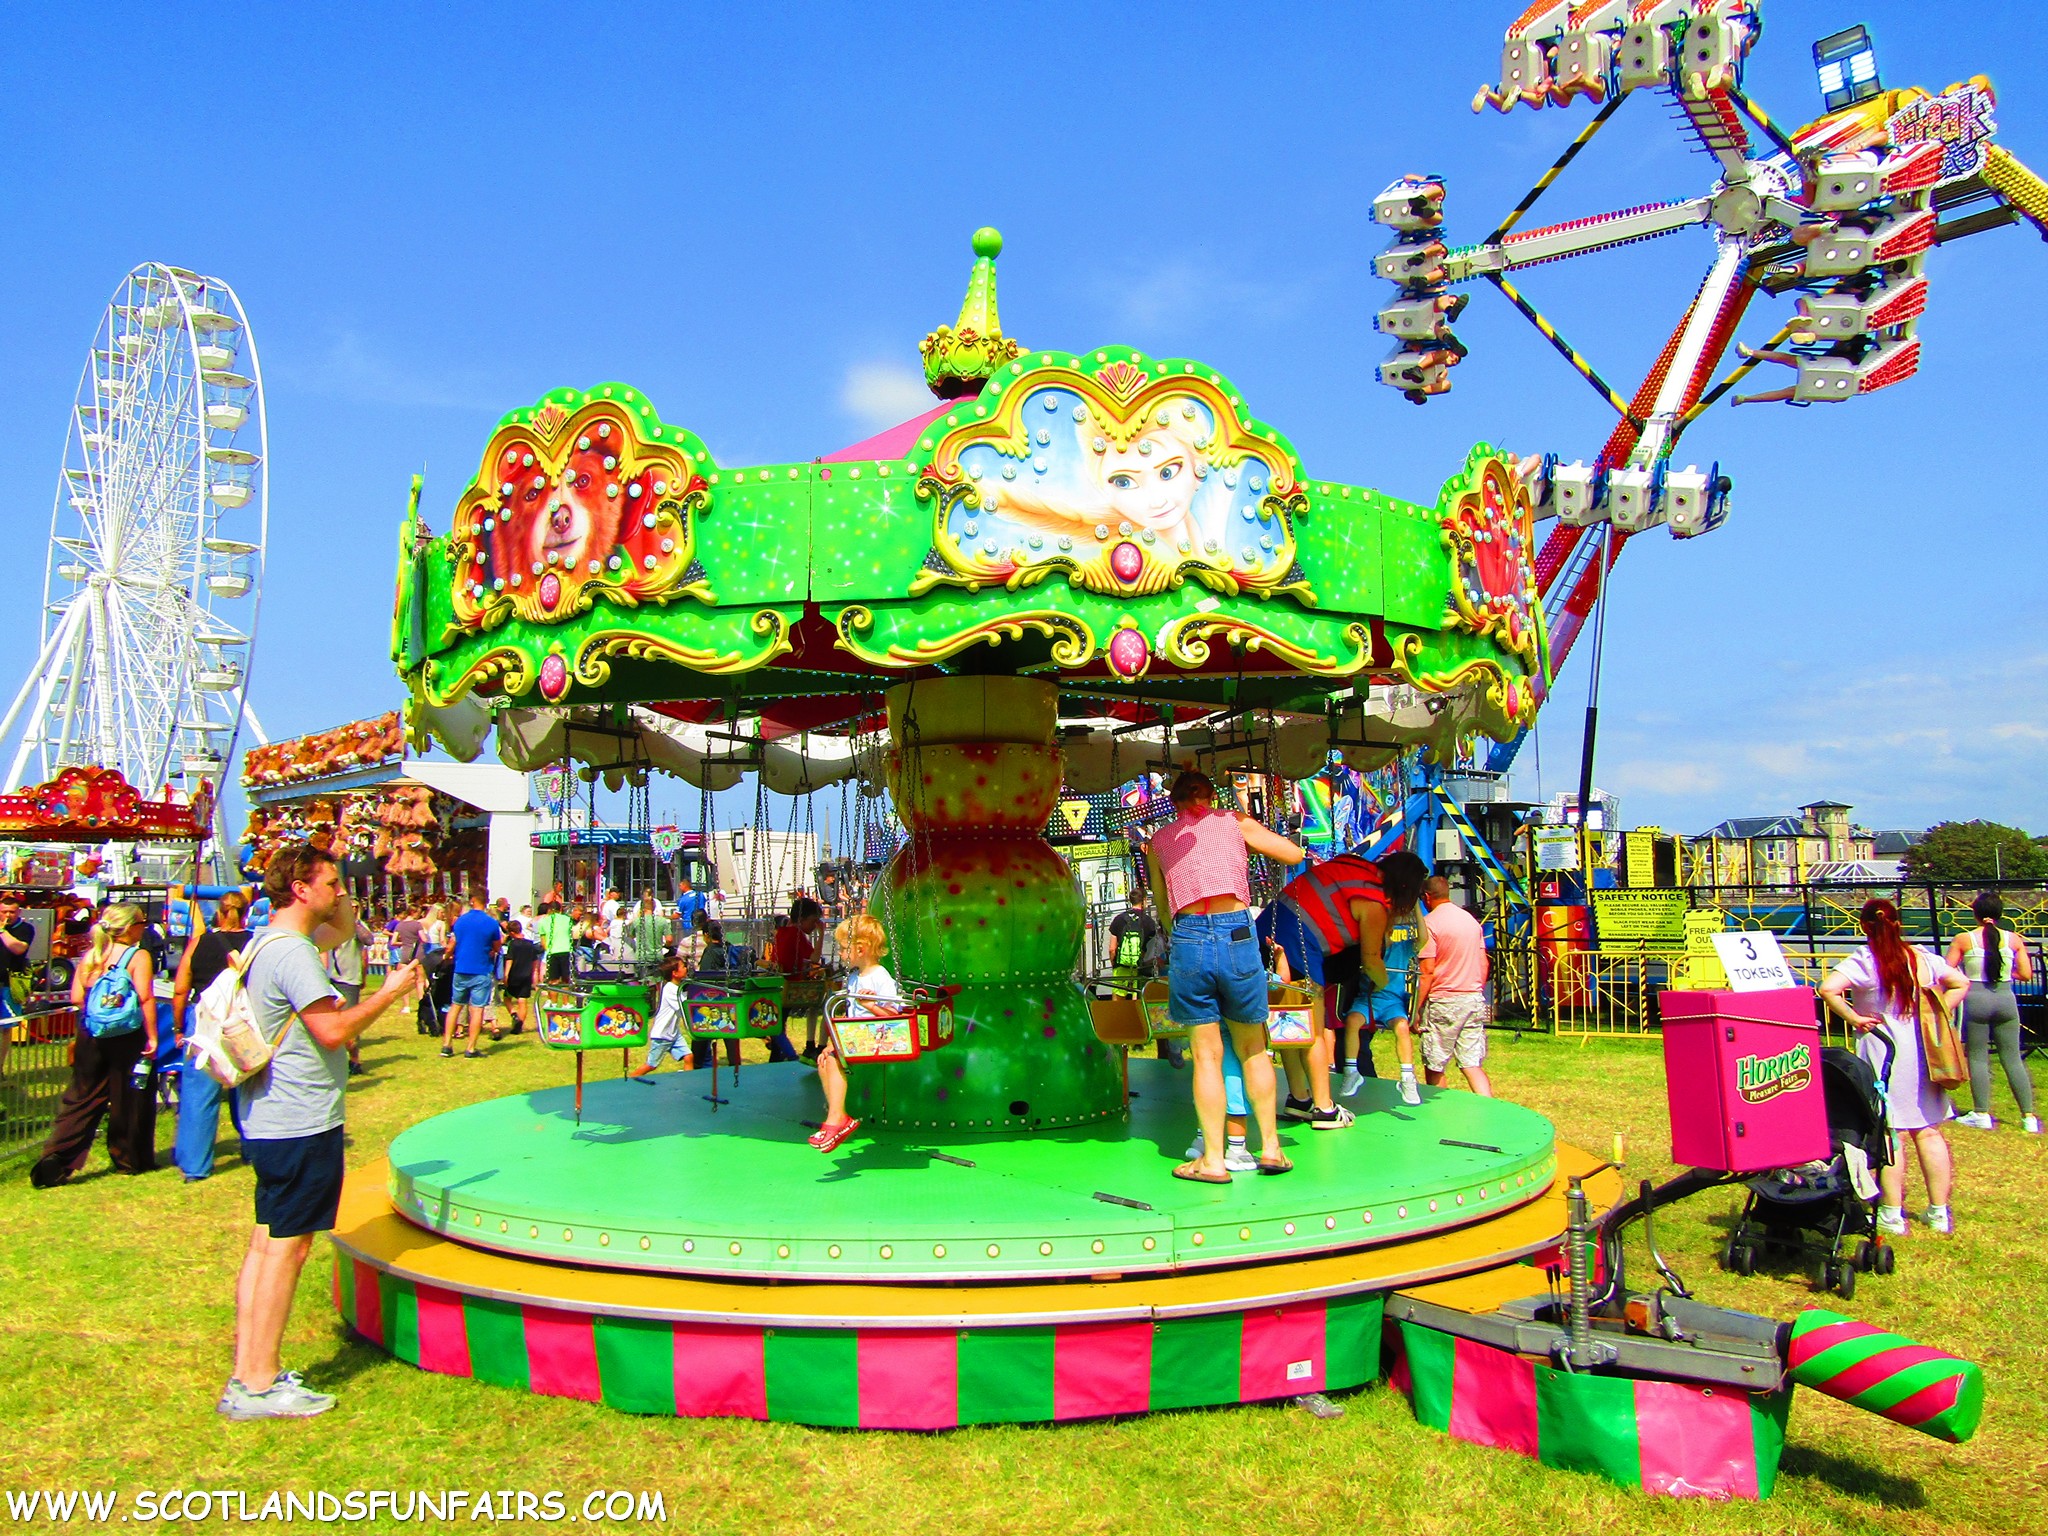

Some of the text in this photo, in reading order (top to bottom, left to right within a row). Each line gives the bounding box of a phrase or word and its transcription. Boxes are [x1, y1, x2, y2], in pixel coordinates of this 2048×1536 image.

[539, 832, 569, 845] TICKETS
[1545, 883, 1554, 893] 4
[1689, 927, 1718, 935] FREAK
[1740, 937, 1757, 961] 3
[1733, 966, 1784, 980] TOKENS
[1749, 1074, 1799, 1101] Pleasure Fairs
